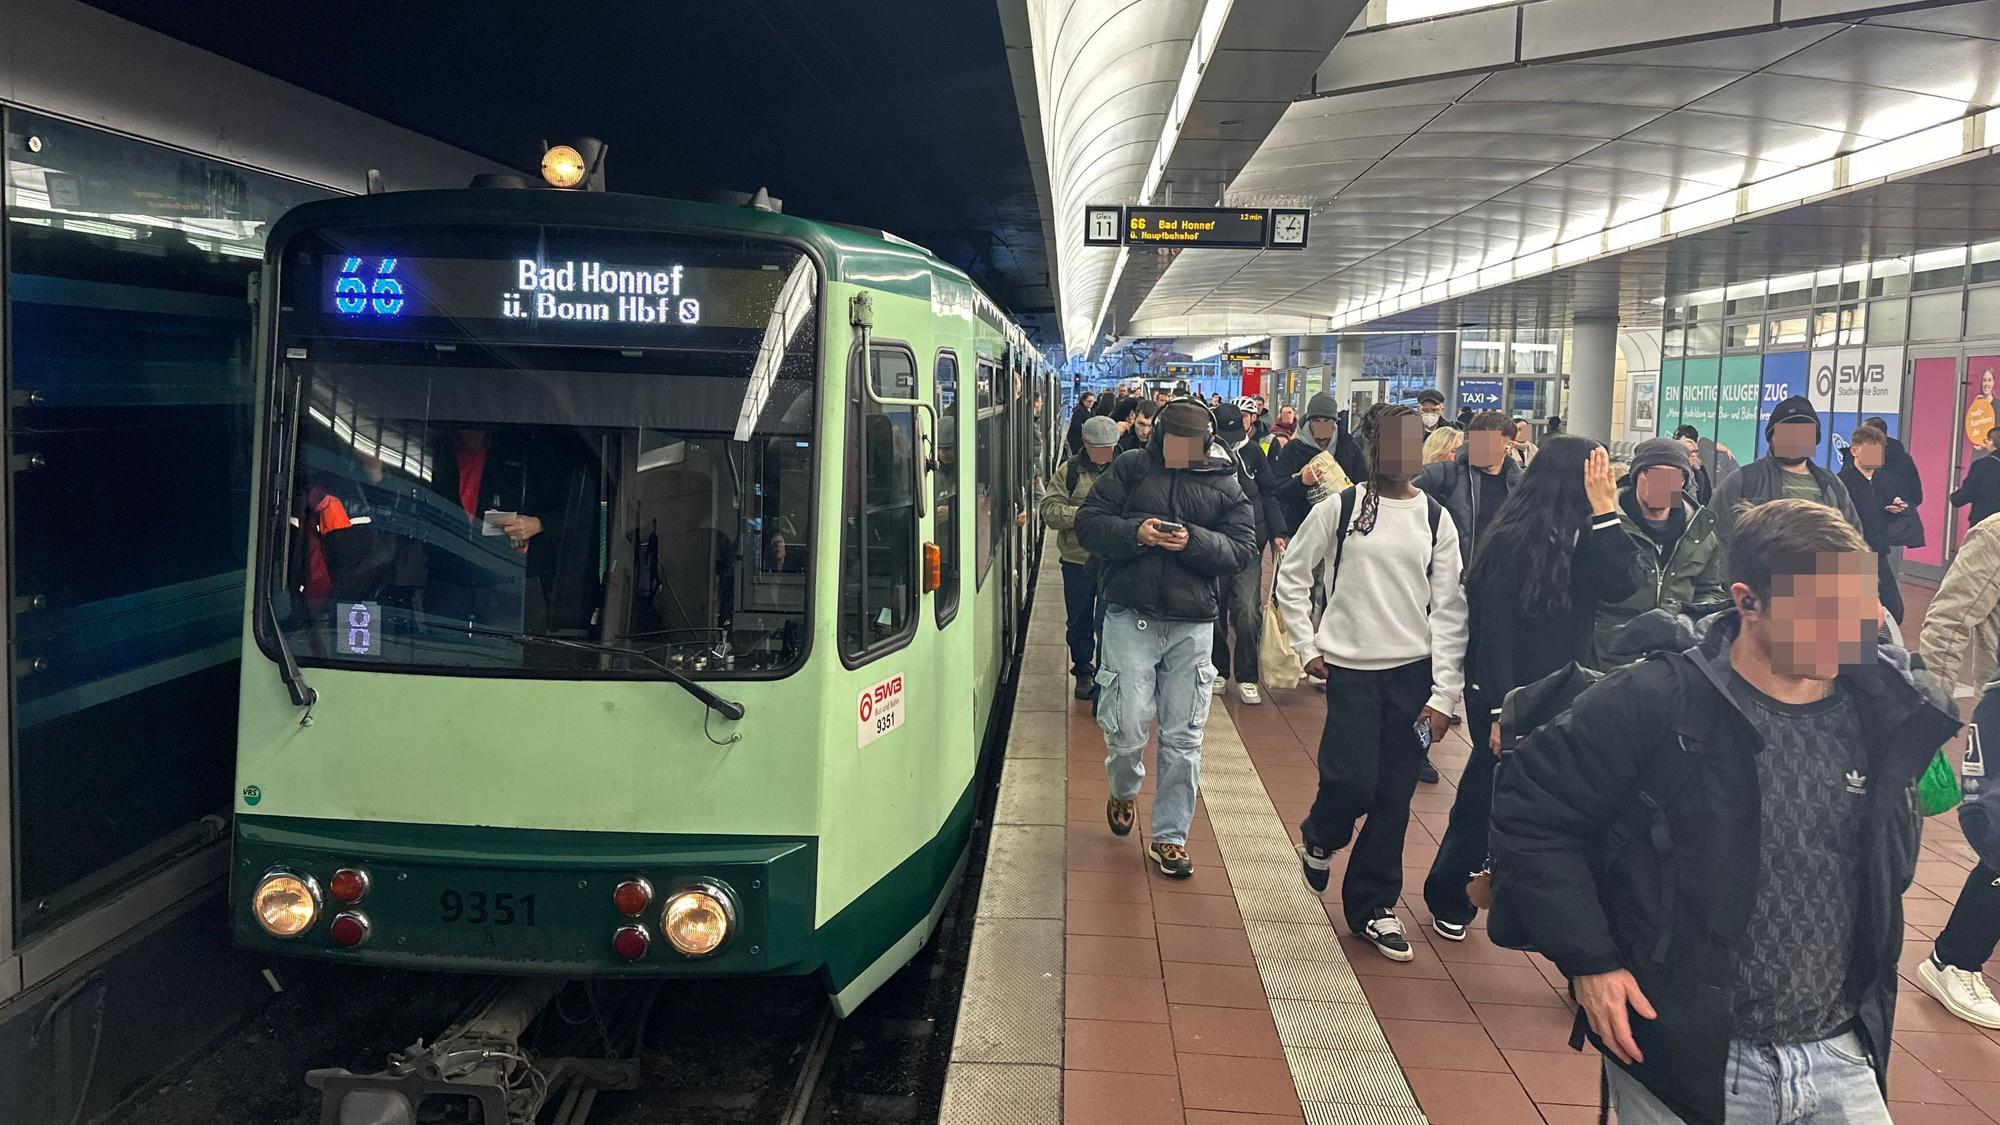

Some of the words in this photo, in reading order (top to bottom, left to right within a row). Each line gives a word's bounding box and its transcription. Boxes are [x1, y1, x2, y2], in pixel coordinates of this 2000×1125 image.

[1096, 212, 1111, 220] Gleis
[1130, 217, 1146, 230] 66
[1158, 219, 1178, 230] Bad
[1181, 220, 1216, 231] Honnef
[1240, 213, 1249, 221] 12
[1249, 213, 1263, 221] min
[1096, 221, 1111, 236] 11
[1141, 231, 1200, 240] Hauptbahnhof
[518, 258, 575, 292] Bad
[582, 262, 684, 296] Honnef
[336, 256, 404, 316] 66
[502, 292, 528, 318] ü.
[536, 292, 609, 321] Bonn
[618, 295, 669, 324] Hbf
[1839, 364, 1885, 384] SWB
[1462, 392, 1485, 403] TAXI
[1665, 385, 1680, 401] EIN
[1682, 384, 1719, 401] RICHTIG
[1722, 384, 1760, 401] KLUGER
[1763, 382, 1789, 401] ZUG
[1872, 386, 1889, 396] Bonn
[875, 677, 902, 704] SWB
[877, 711, 895, 734] 9351
[243, 788, 257, 796] VRS
[440, 889, 537, 927] 9351
